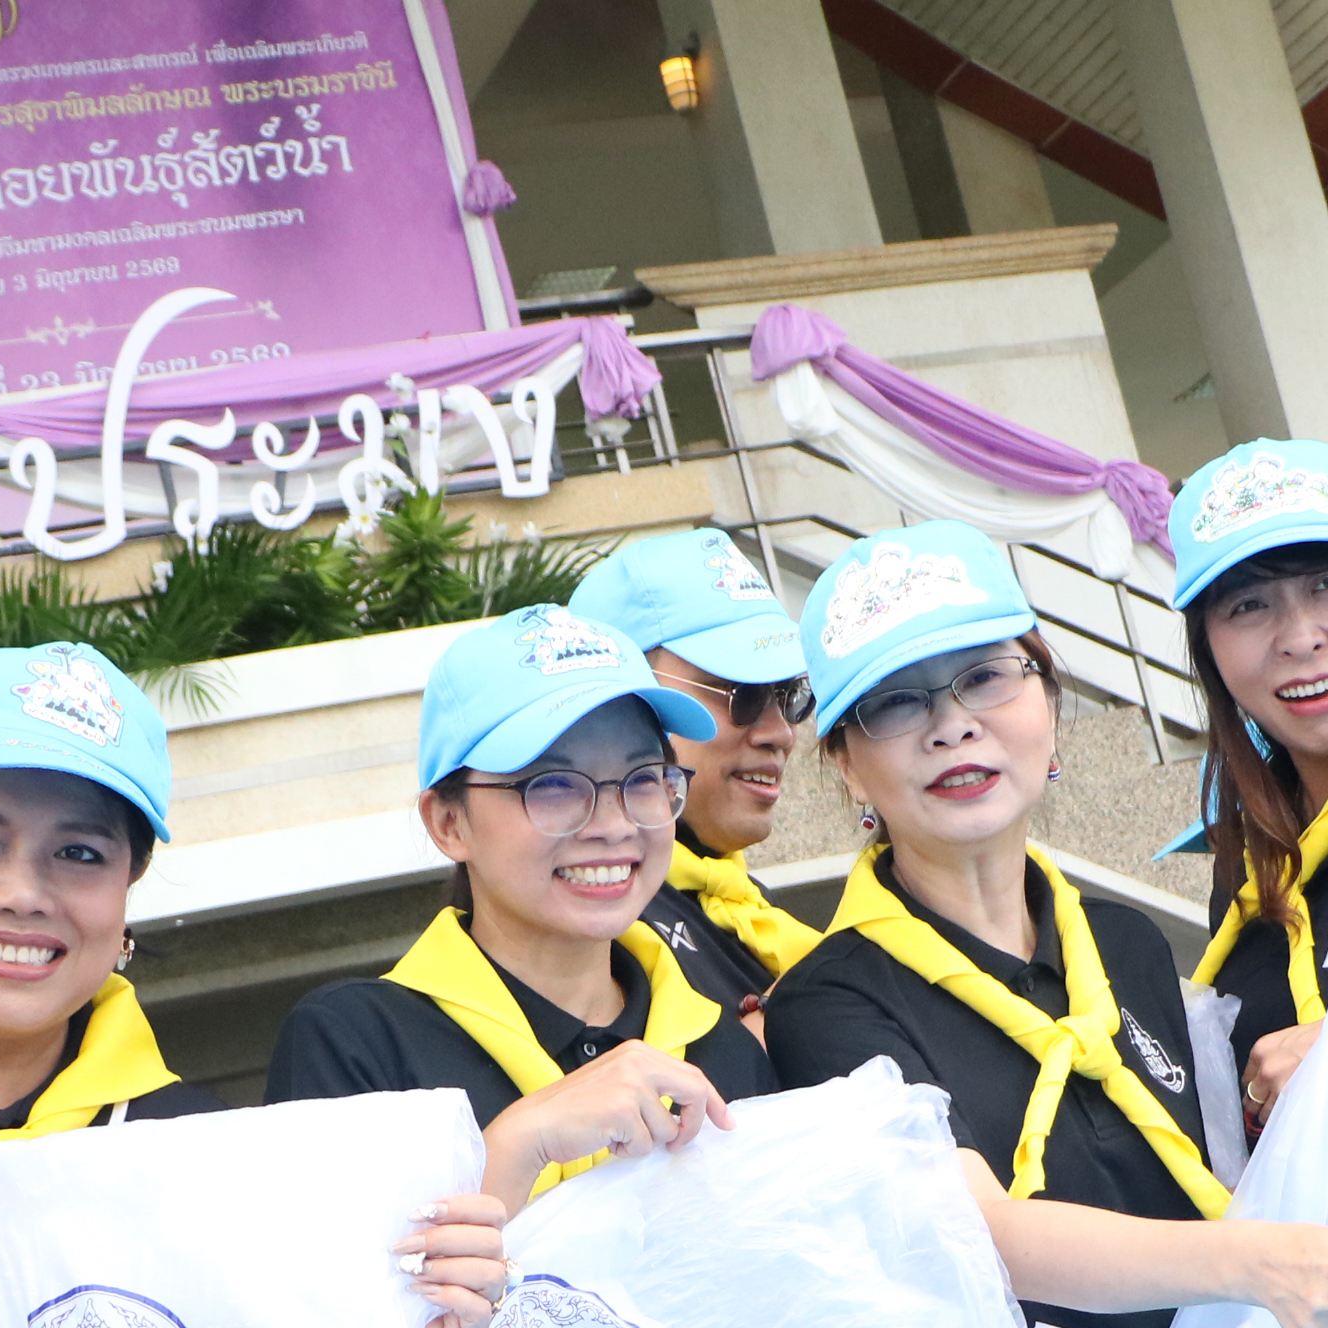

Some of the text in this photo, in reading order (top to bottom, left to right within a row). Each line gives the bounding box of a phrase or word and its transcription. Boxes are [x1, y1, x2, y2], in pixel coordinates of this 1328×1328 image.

[220, 60, 398, 105] พระบรมราชินี
[13, 274, 28, 292] 3
[35, 264, 119, 293] มิถุนายน
[125, 256, 181, 280] 2569
